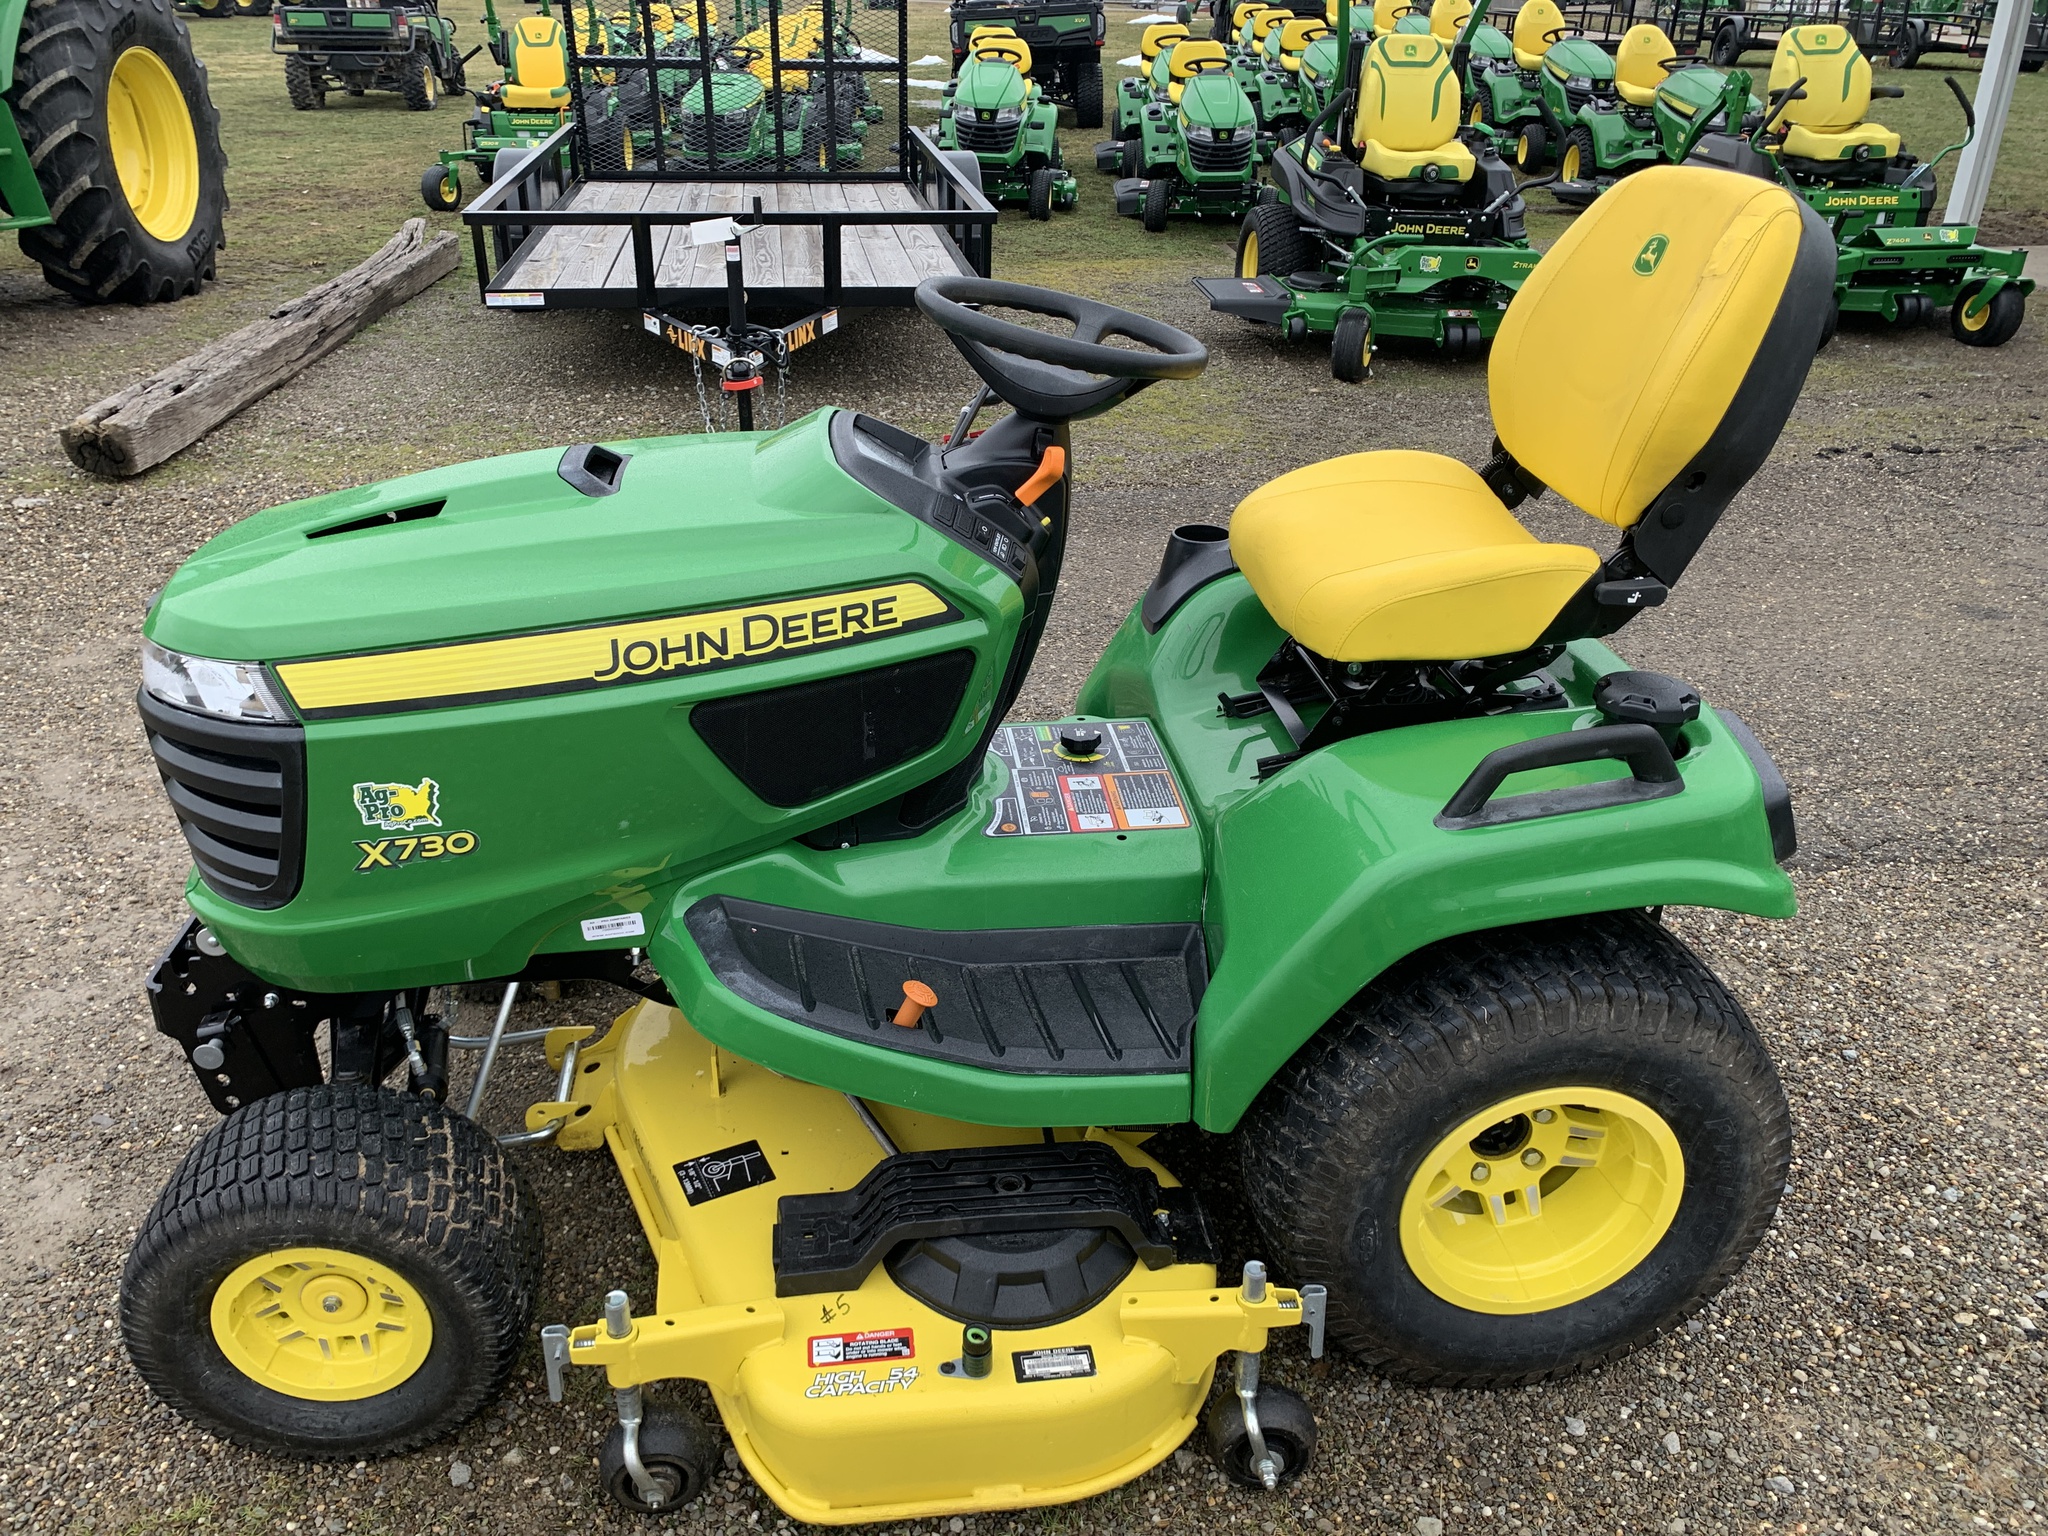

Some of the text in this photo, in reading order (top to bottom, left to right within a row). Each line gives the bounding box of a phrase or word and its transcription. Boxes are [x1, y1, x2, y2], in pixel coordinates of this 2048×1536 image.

[1825, 195, 1899, 206] JOHN DEERE
[1391, 222, 1466, 235] JOHN DEERE
[786, 320, 816, 352] LINX
[594, 596, 898, 677] JOHN DEERE
[359, 786, 398, 805] Ag-
[363, 803, 404, 821] Pro
[358, 831, 477, 870] X730
[864, 1330, 895, 1338] DANGER
[814, 1366, 920, 1386] HIGH 54
[805, 1378, 917, 1398] CAPACITY
